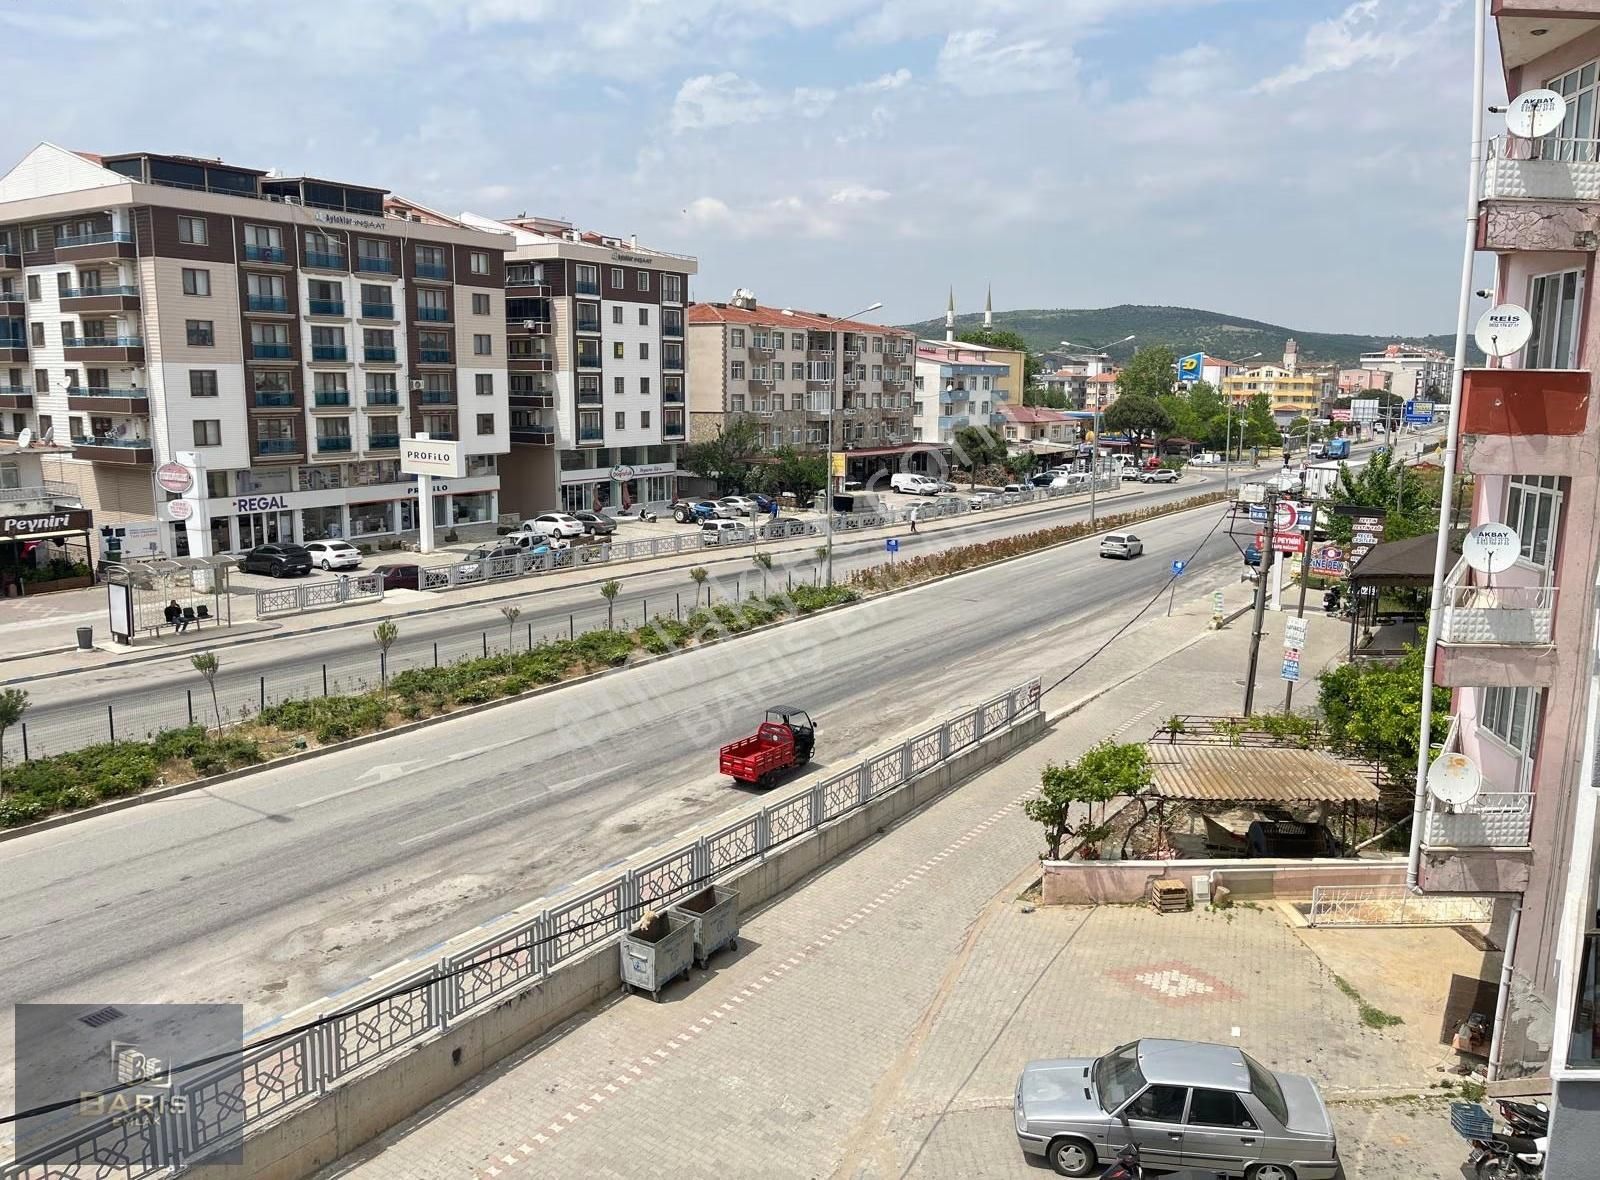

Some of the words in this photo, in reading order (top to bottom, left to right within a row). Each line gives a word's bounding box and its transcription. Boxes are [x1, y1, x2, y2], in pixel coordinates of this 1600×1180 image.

[1489, 314, 1520, 322] REİS
[407, 484, 448, 494] PRiLO
[238, 496, 288, 512] REGAL
[4, 514, 70, 532] Peyniri
